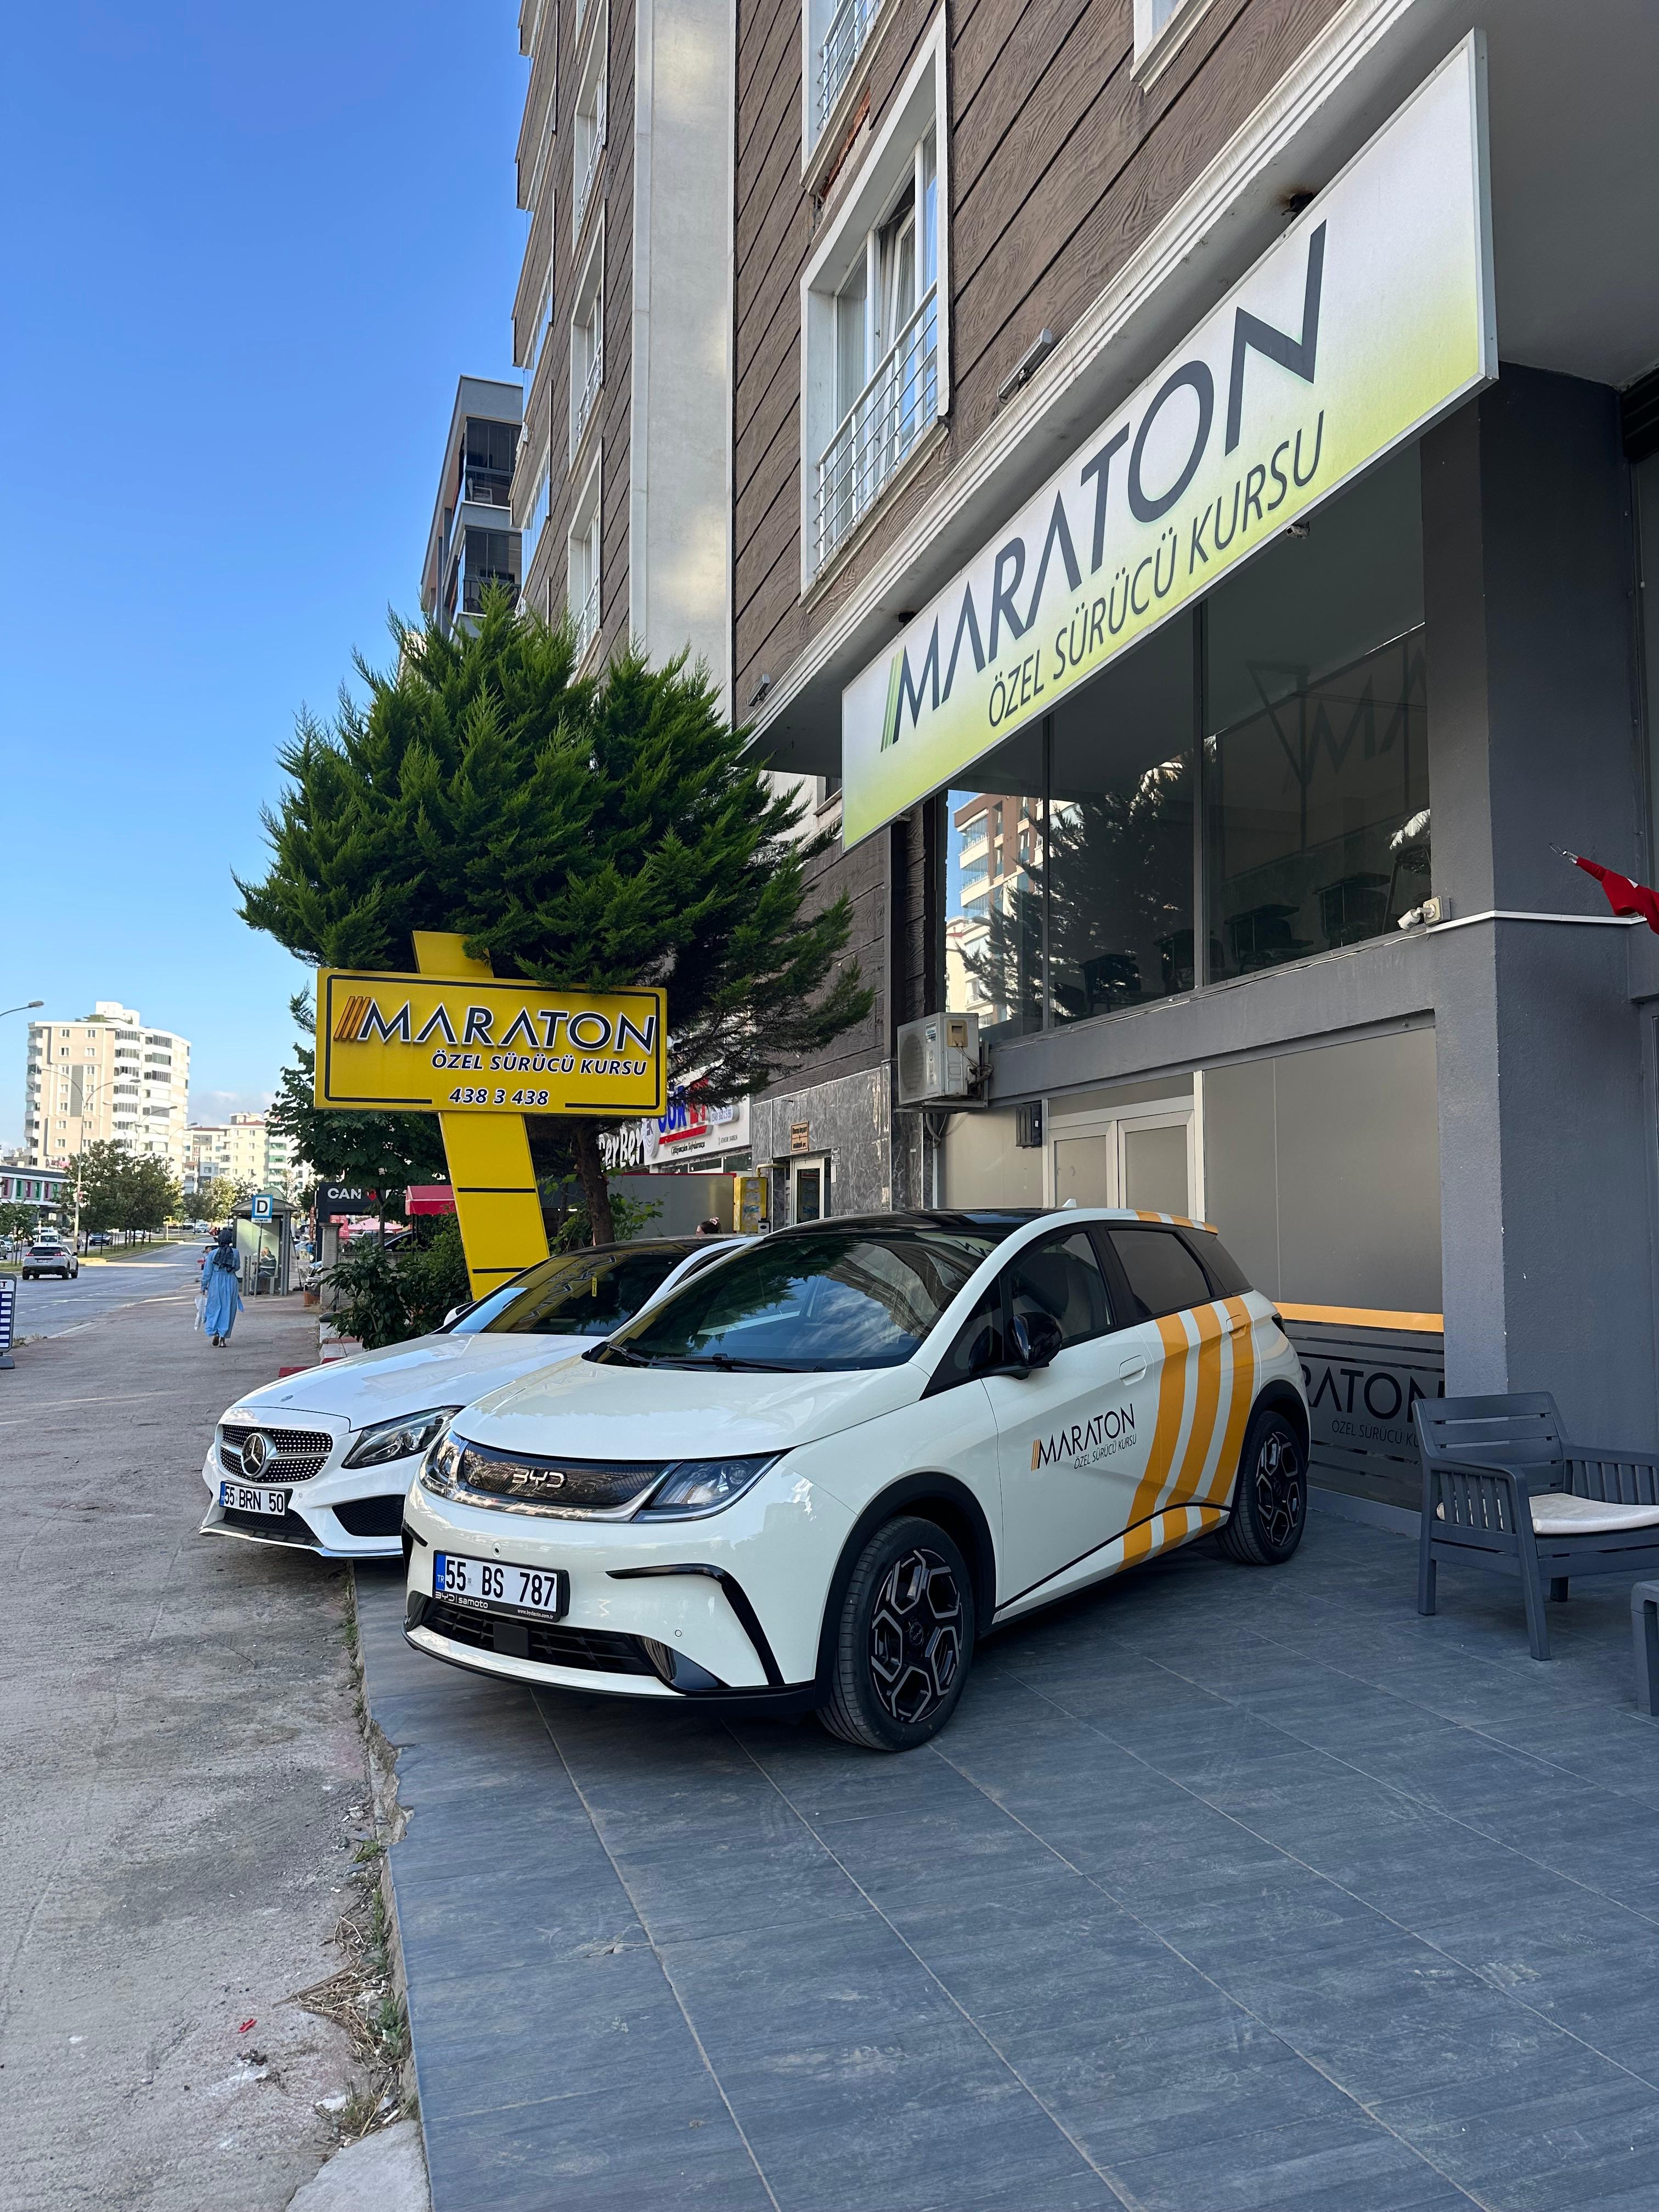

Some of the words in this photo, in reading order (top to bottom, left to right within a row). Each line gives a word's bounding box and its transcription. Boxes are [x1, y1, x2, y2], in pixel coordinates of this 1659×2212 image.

[892, 219, 1327, 744] MARATON
[988, 654, 1045, 727] ÖZEL
[1054, 527, 1175, 681] SÜRÜCÜ
[1189, 409, 1324, 575] KURSU
[357, 997, 656, 1056] MARATON
[431, 1049, 483, 1070] ÖZEL
[490, 1052, 575, 1074] SÜRÜCÜ
[580, 1059, 647, 1076] KURSU
[449, 1087, 488, 1104] 438
[494, 1088, 505, 1104] 3
[511, 1090, 549, 1105] 438
[256, 1200, 268, 1213] D
[327, 1188, 362, 1200] CAN
[1037, 1403, 1136, 1469] MARATON
[1331, 1418, 1357, 1436] ÖZEL
[1359, 1424, 1403, 1444] SÜRÜCÜ
[1074, 1454, 1091, 1470] ÖZEL
[1092, 1440, 1117, 1463] SÜRÜCÜ
[1118, 1433, 1137, 1451] KURSU
[512, 1468, 565, 1488] BYD
[224, 1485, 235, 1506] 55
[239, 1488, 261, 1510] BRN
[269, 1492, 284, 1513] 50
[437, 1574, 444, 1584] TR
[445, 1559, 466, 1592] 55
[481, 1565, 504, 1598] BS
[519, 1571, 555, 1607] 787
[435, 1590, 455, 1602] BYD
[458, 1596, 488, 1609] samoto
